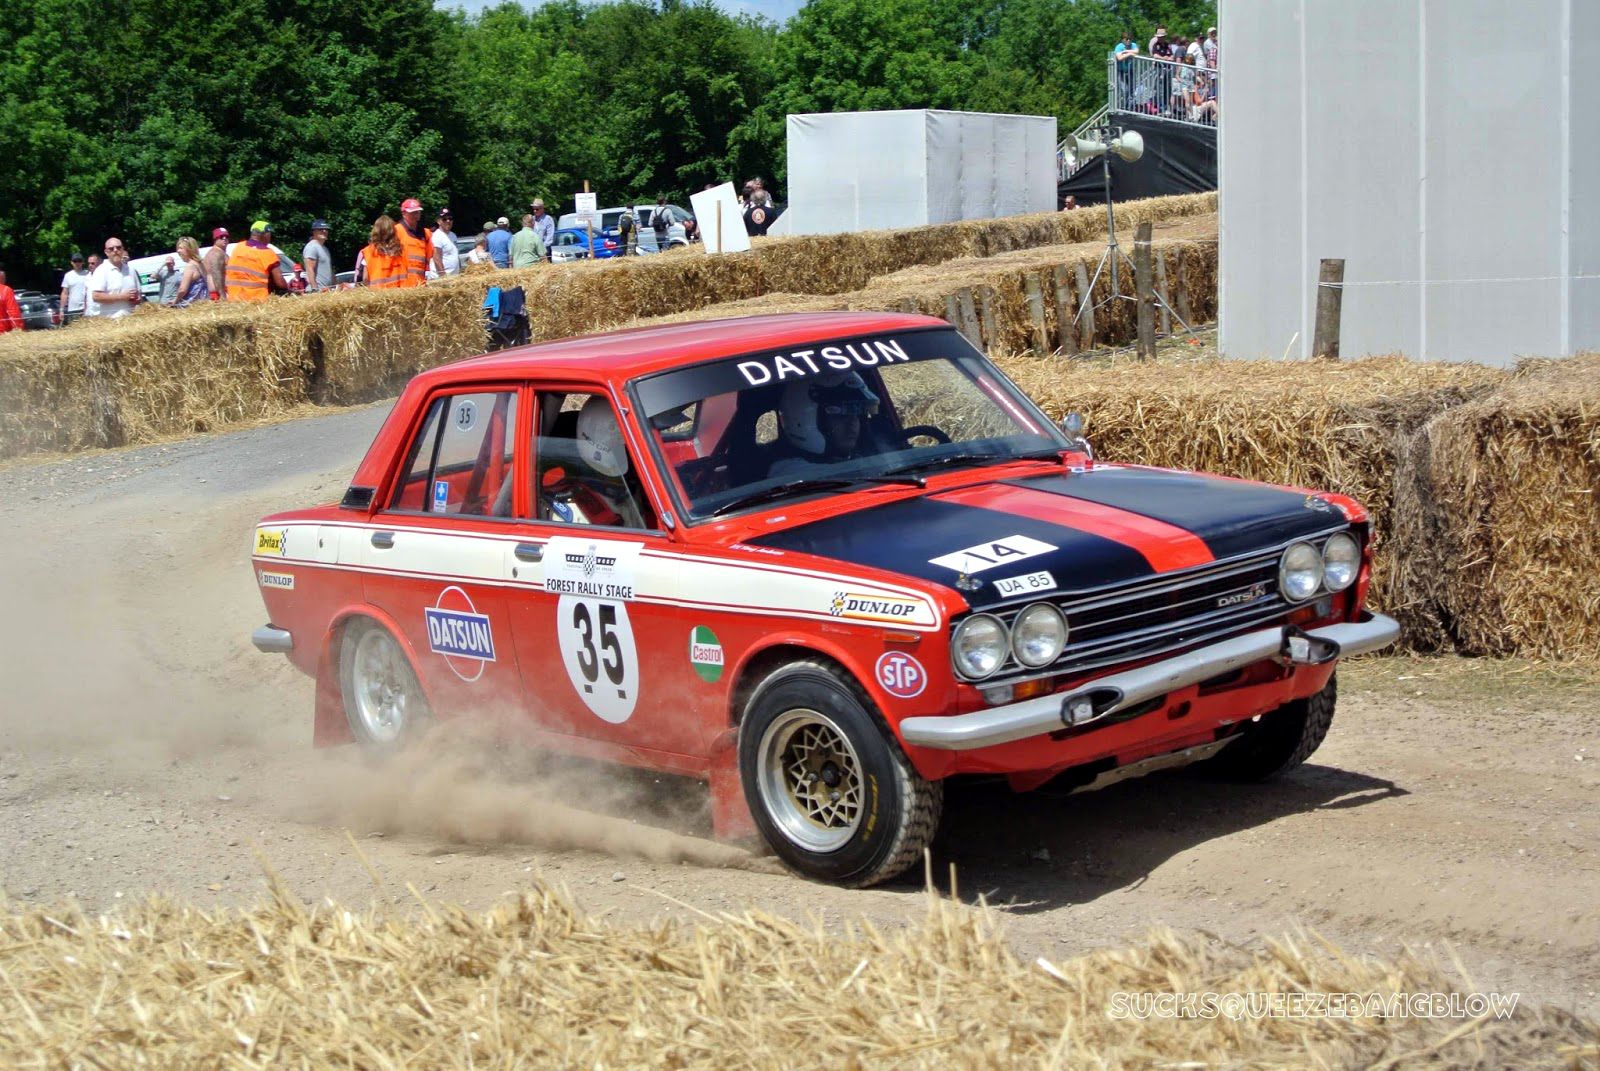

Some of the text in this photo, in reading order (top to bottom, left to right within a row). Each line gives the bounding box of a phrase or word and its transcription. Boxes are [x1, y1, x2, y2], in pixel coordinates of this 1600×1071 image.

[737, 339, 910, 386] DATSUN
[459, 407, 471, 424] 35
[962, 543, 1028, 564] 14
[264, 574, 293, 586] DUNLOP
[546, 578, 632, 598] FOREST RALLY STAGE
[1000, 574, 1050, 593] UA 85
[847, 599, 916, 617] DUNLOP
[429, 616, 491, 654] DATSUN
[573, 602, 625, 686] 35
[693, 645, 722, 663] Castrol
[883, 657, 918, 689] STP
